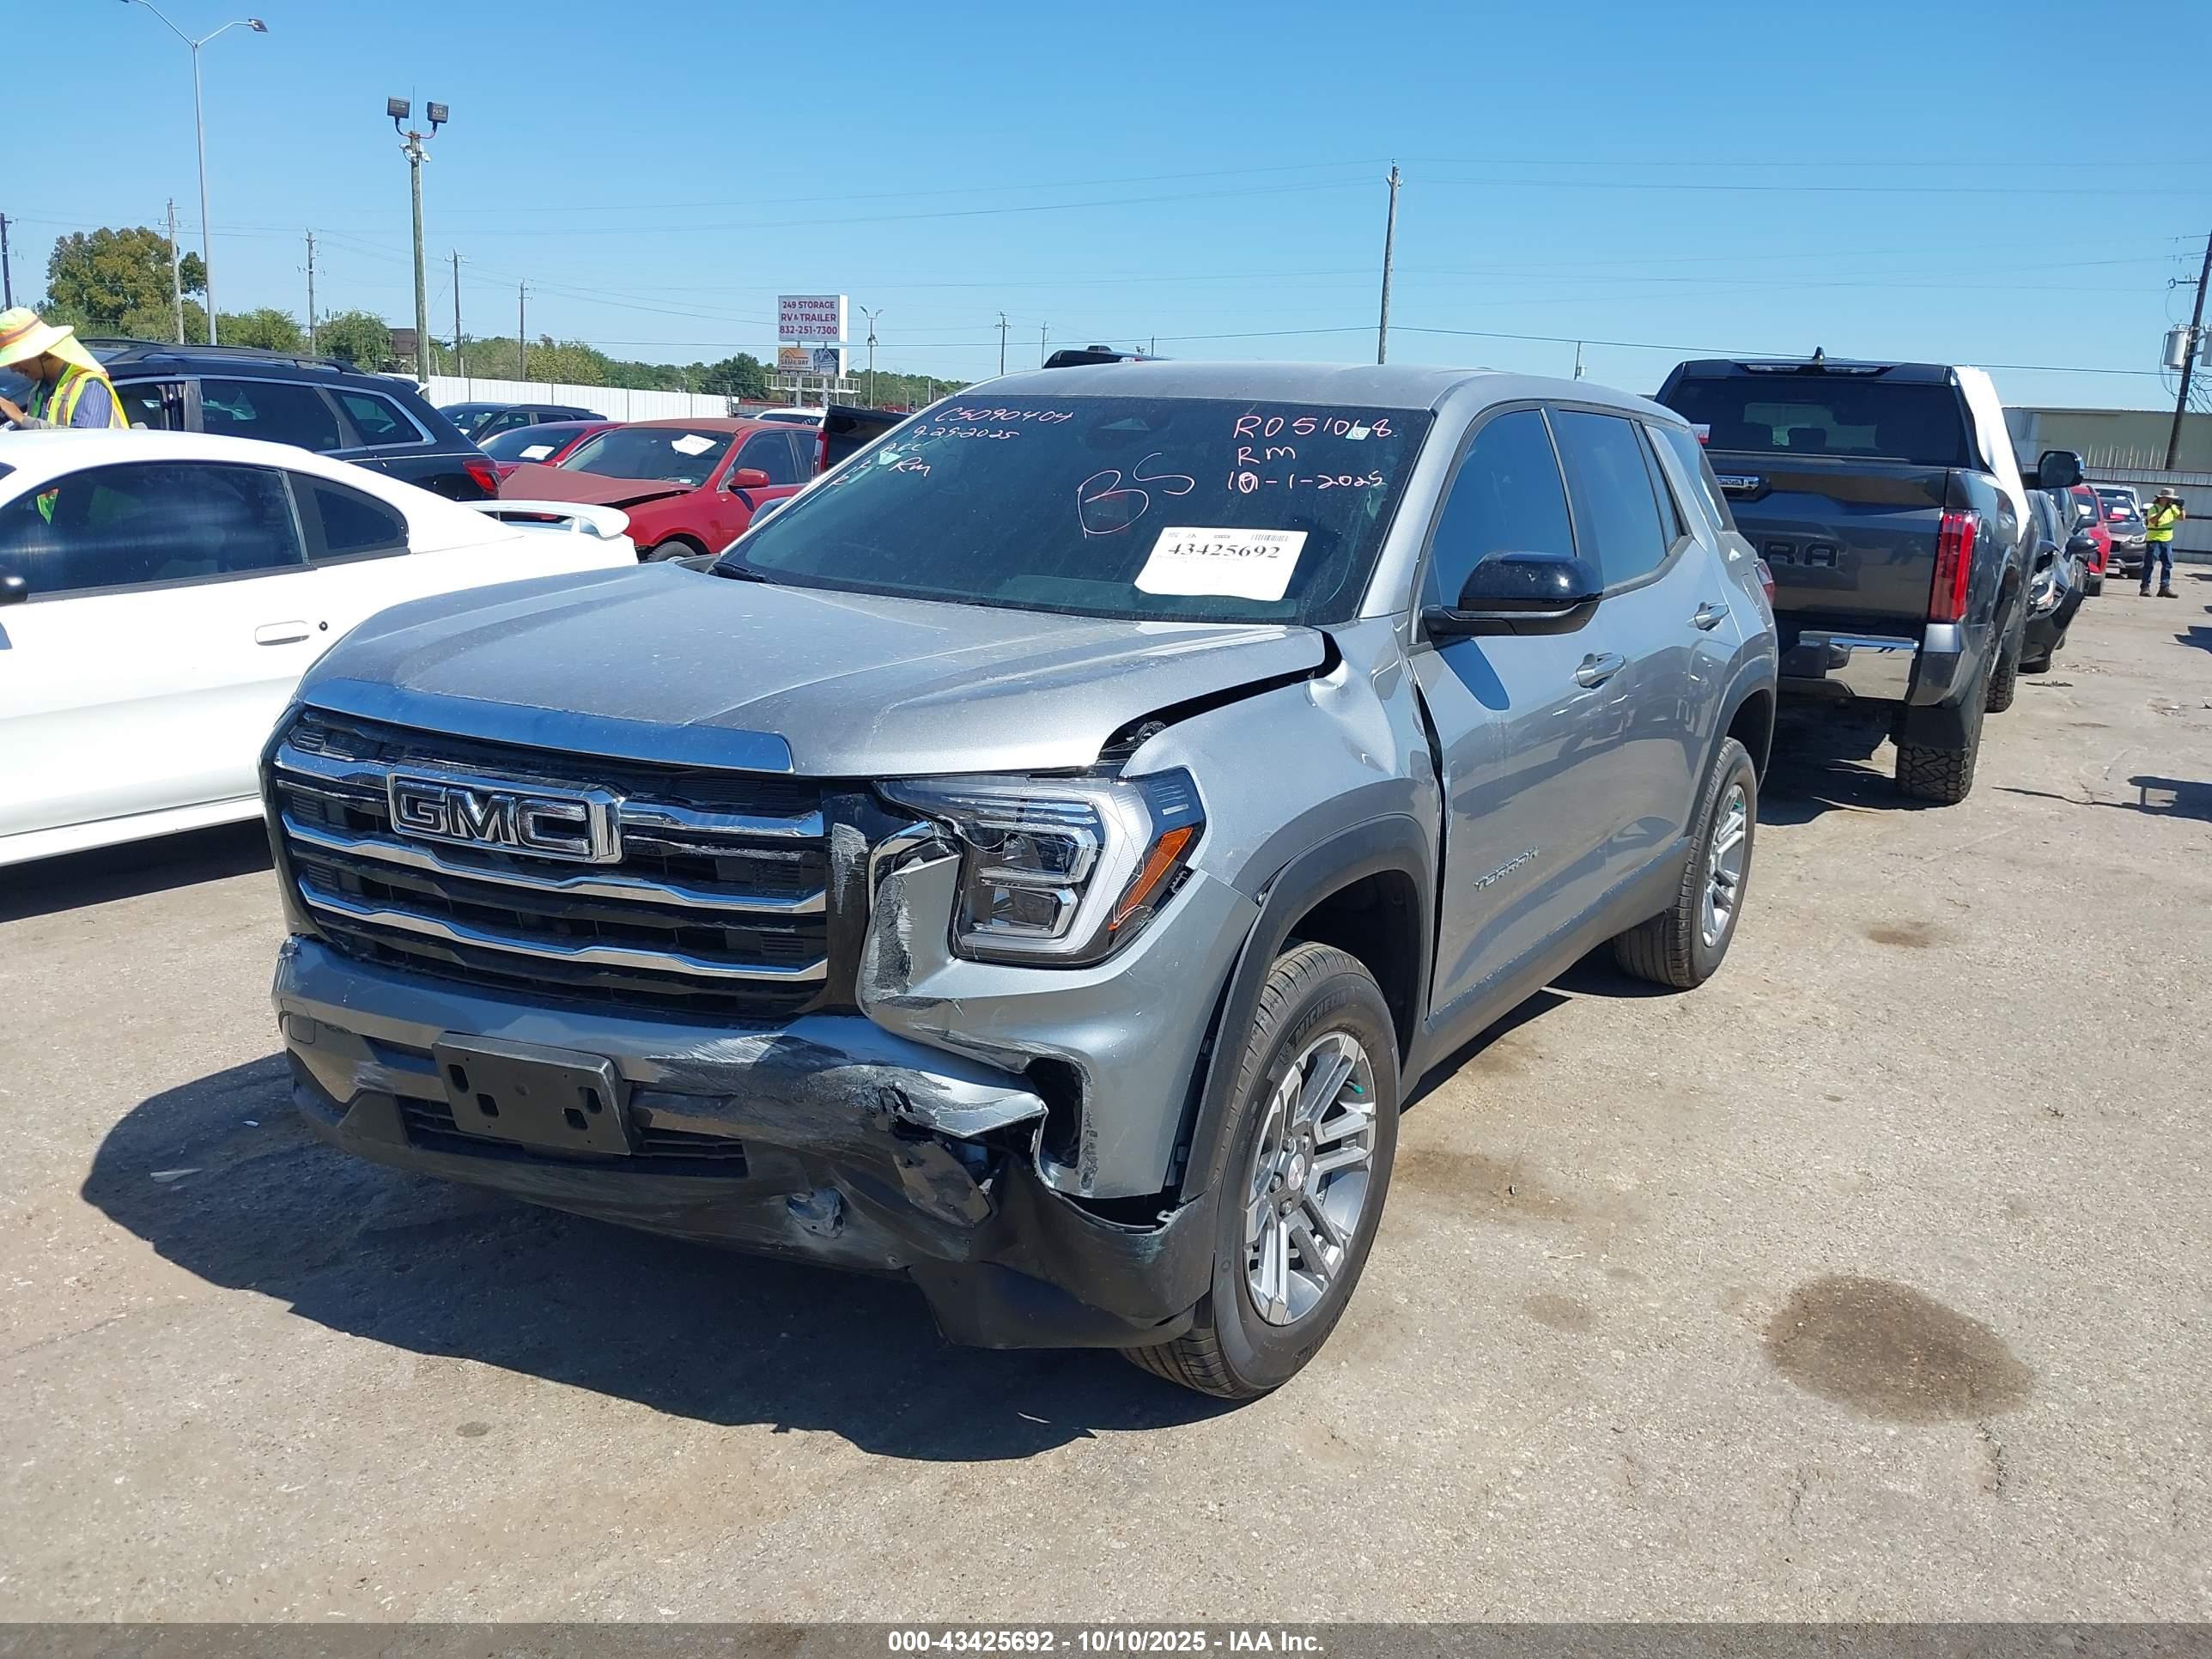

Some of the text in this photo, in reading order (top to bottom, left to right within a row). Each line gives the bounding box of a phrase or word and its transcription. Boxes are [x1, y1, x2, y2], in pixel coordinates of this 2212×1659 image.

[781, 313, 793, 322] RV
[800, 313, 836, 322] TRAILER
[780, 325, 837, 335] 832-251-7300
[1168, 543, 1280, 558] 43425692
[393, 781, 590, 854] GMC
[1472, 845, 1539, 891] TERRAIN
